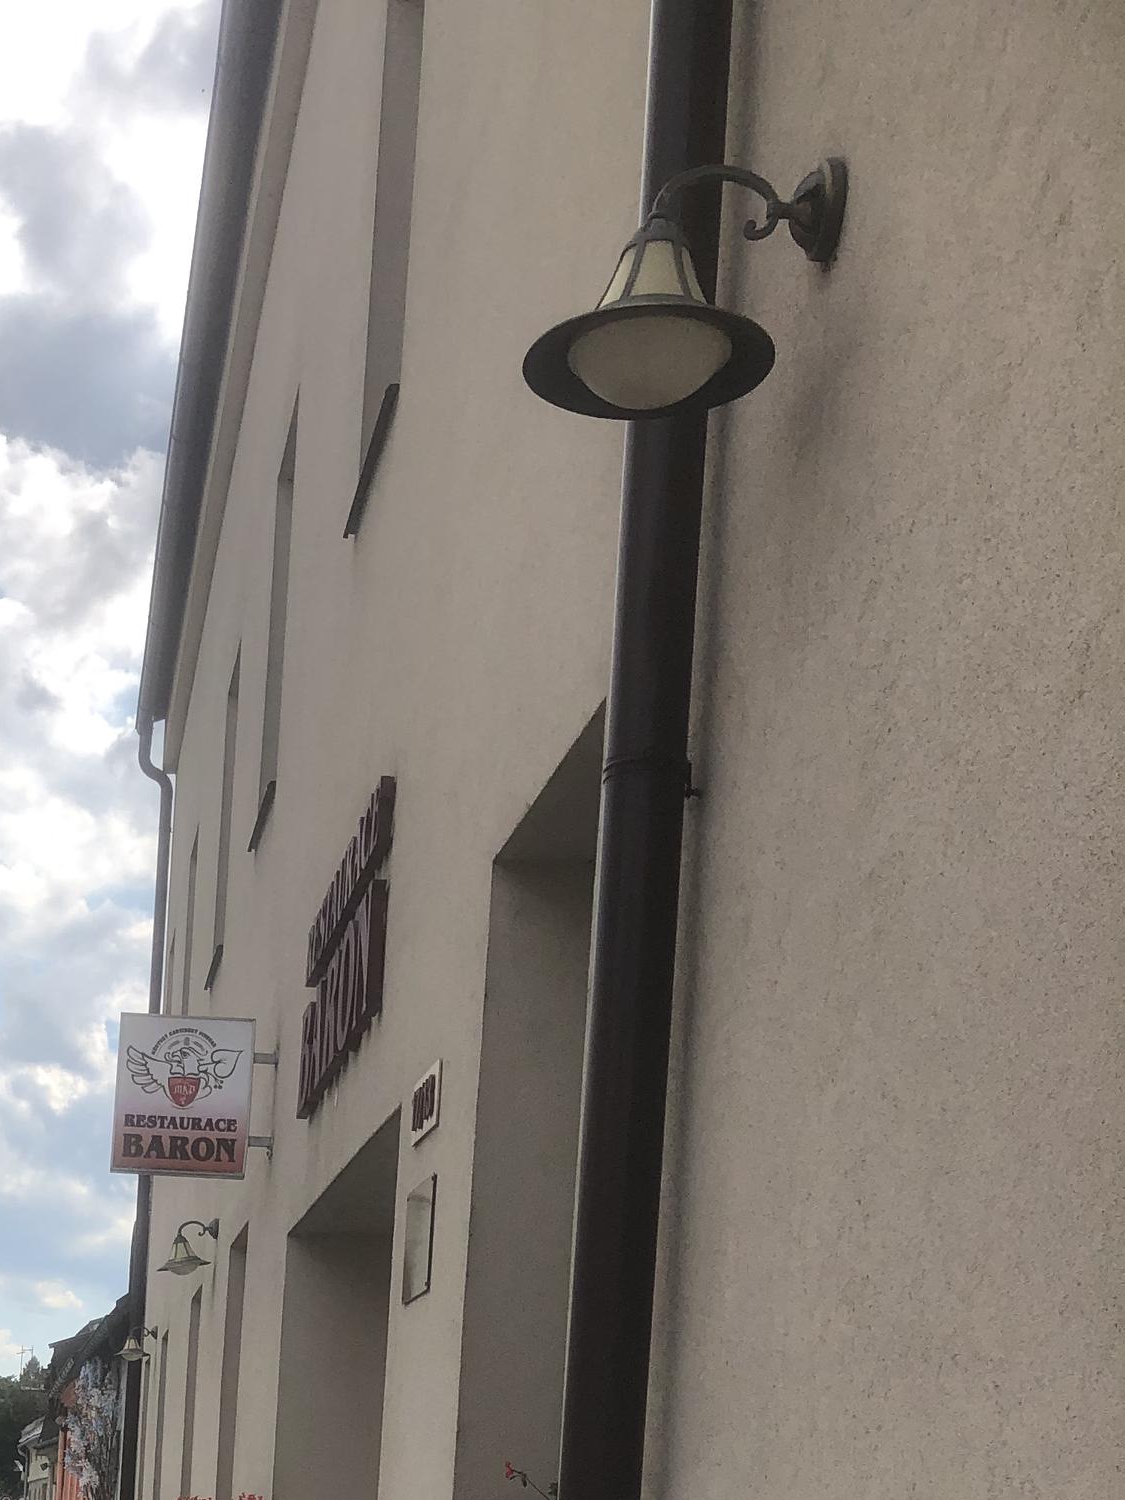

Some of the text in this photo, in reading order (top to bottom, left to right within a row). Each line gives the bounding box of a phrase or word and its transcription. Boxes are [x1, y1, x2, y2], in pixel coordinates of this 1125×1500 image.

[296, 876, 387, 1118] BARON
[124, 1114, 237, 1133] RESTAURACE
[122, 1133, 237, 1163] BARON
